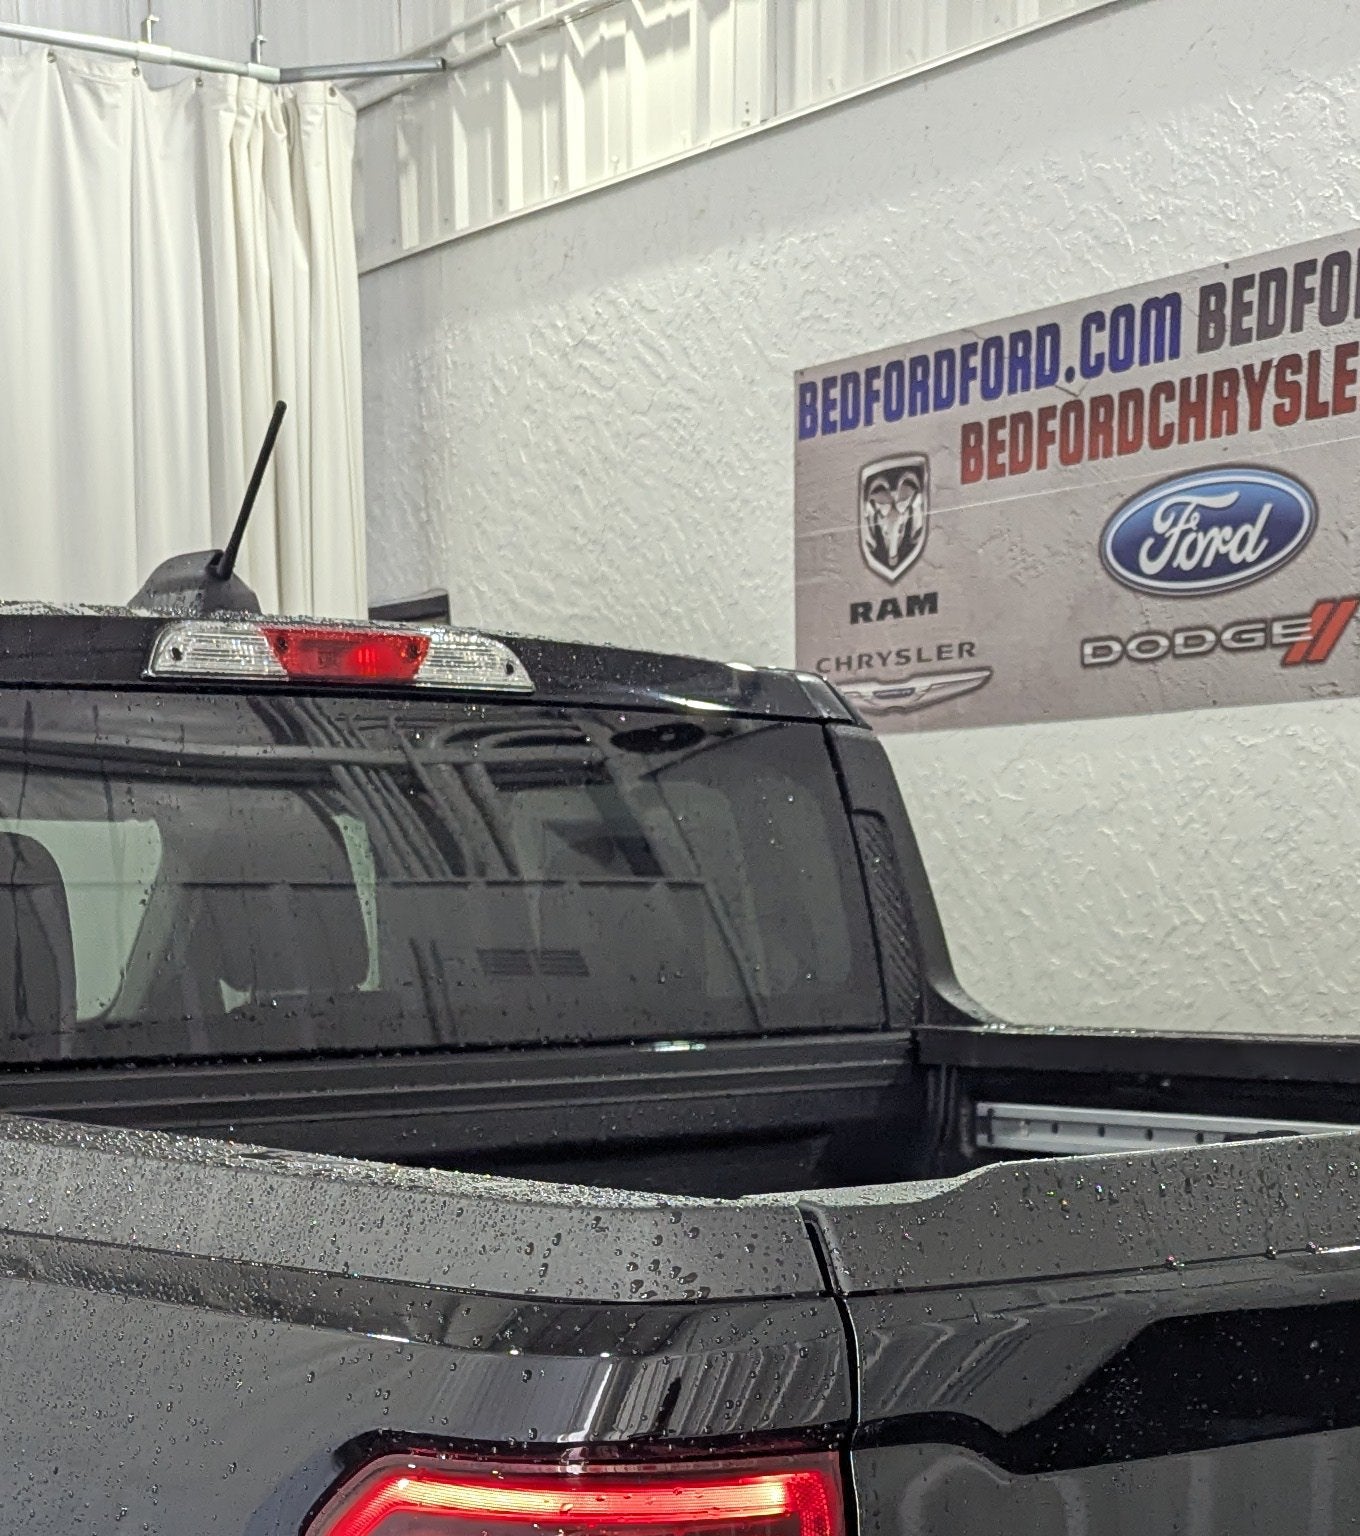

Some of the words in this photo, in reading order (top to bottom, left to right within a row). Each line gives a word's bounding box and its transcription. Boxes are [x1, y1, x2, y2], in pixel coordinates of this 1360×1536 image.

[798, 292, 1182, 440] BEDFORDFORD.COM
[1138, 491, 1274, 576] Ford
[849, 592, 938, 624] RAM
[816, 641, 976, 674] CHRYSLER
[1081, 614, 1314, 667] DODGE
